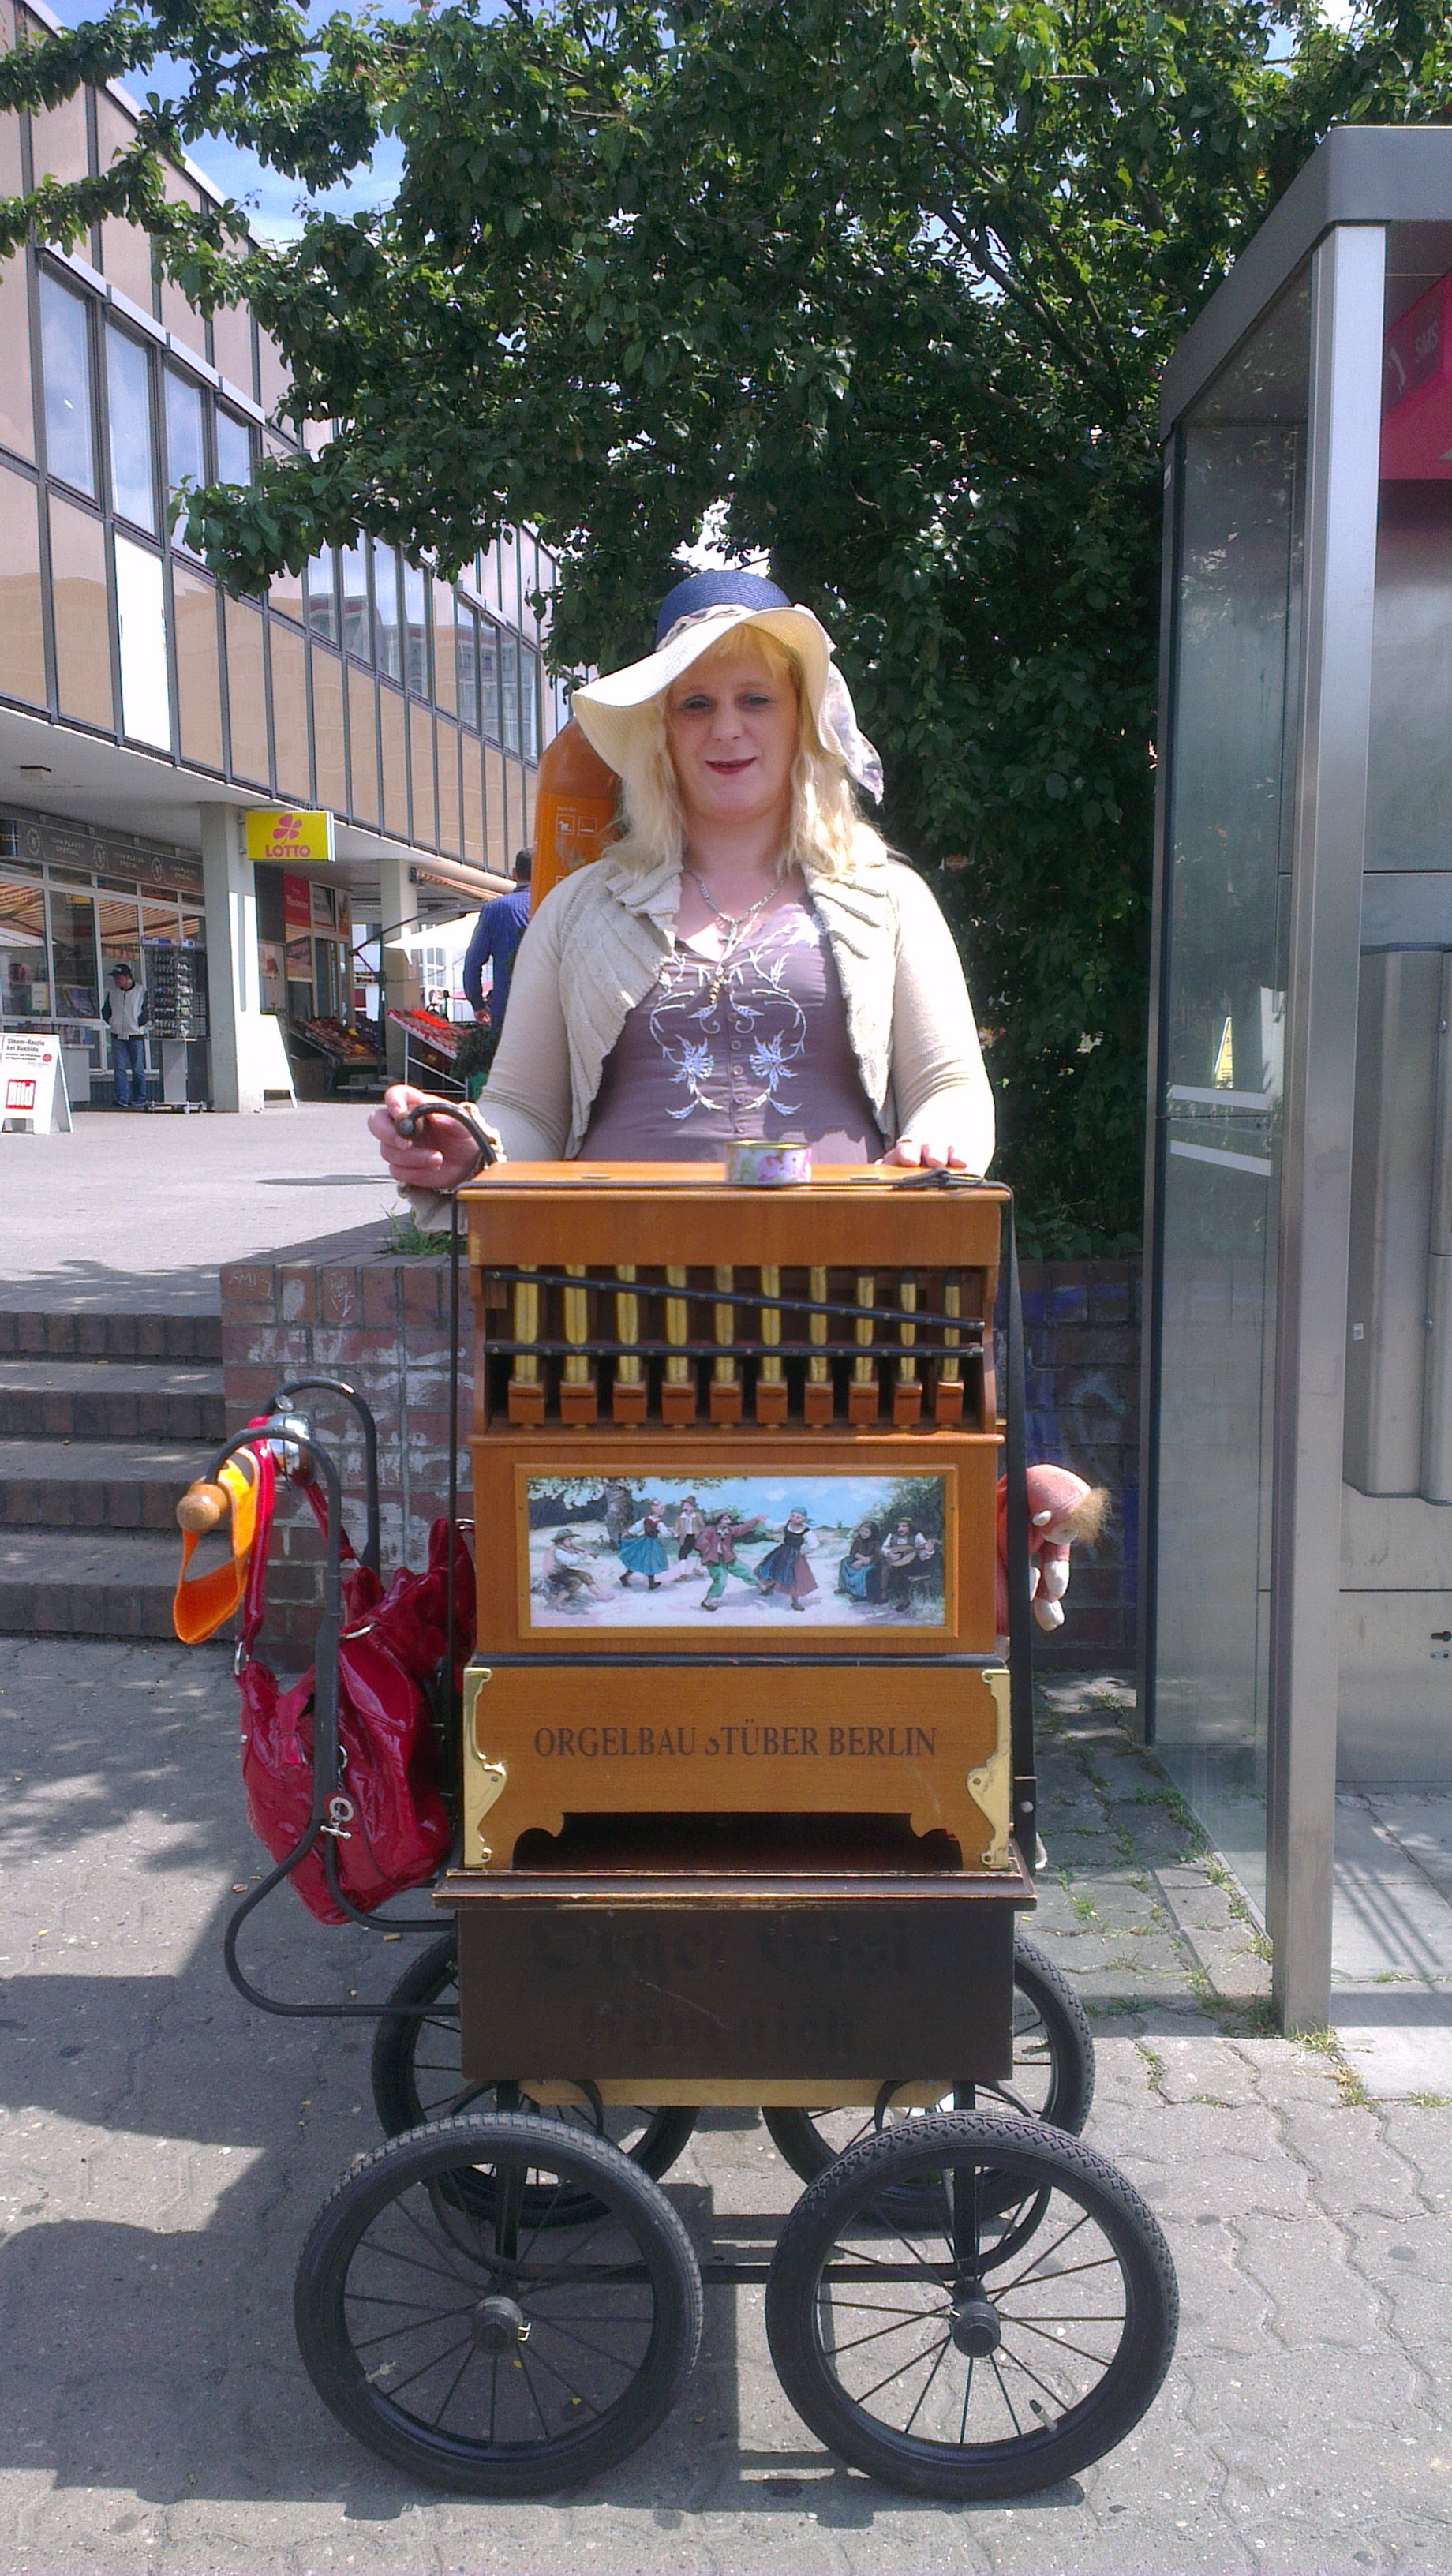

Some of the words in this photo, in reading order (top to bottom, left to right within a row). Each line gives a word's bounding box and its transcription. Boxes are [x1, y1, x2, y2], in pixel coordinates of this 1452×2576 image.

[265, 844, 311, 858] LOTTO
[7, 1080, 35, 1106] Bild
[534, 1727, 696, 1757] ORGELBAU
[828, 1726, 937, 1756] BERLIN
